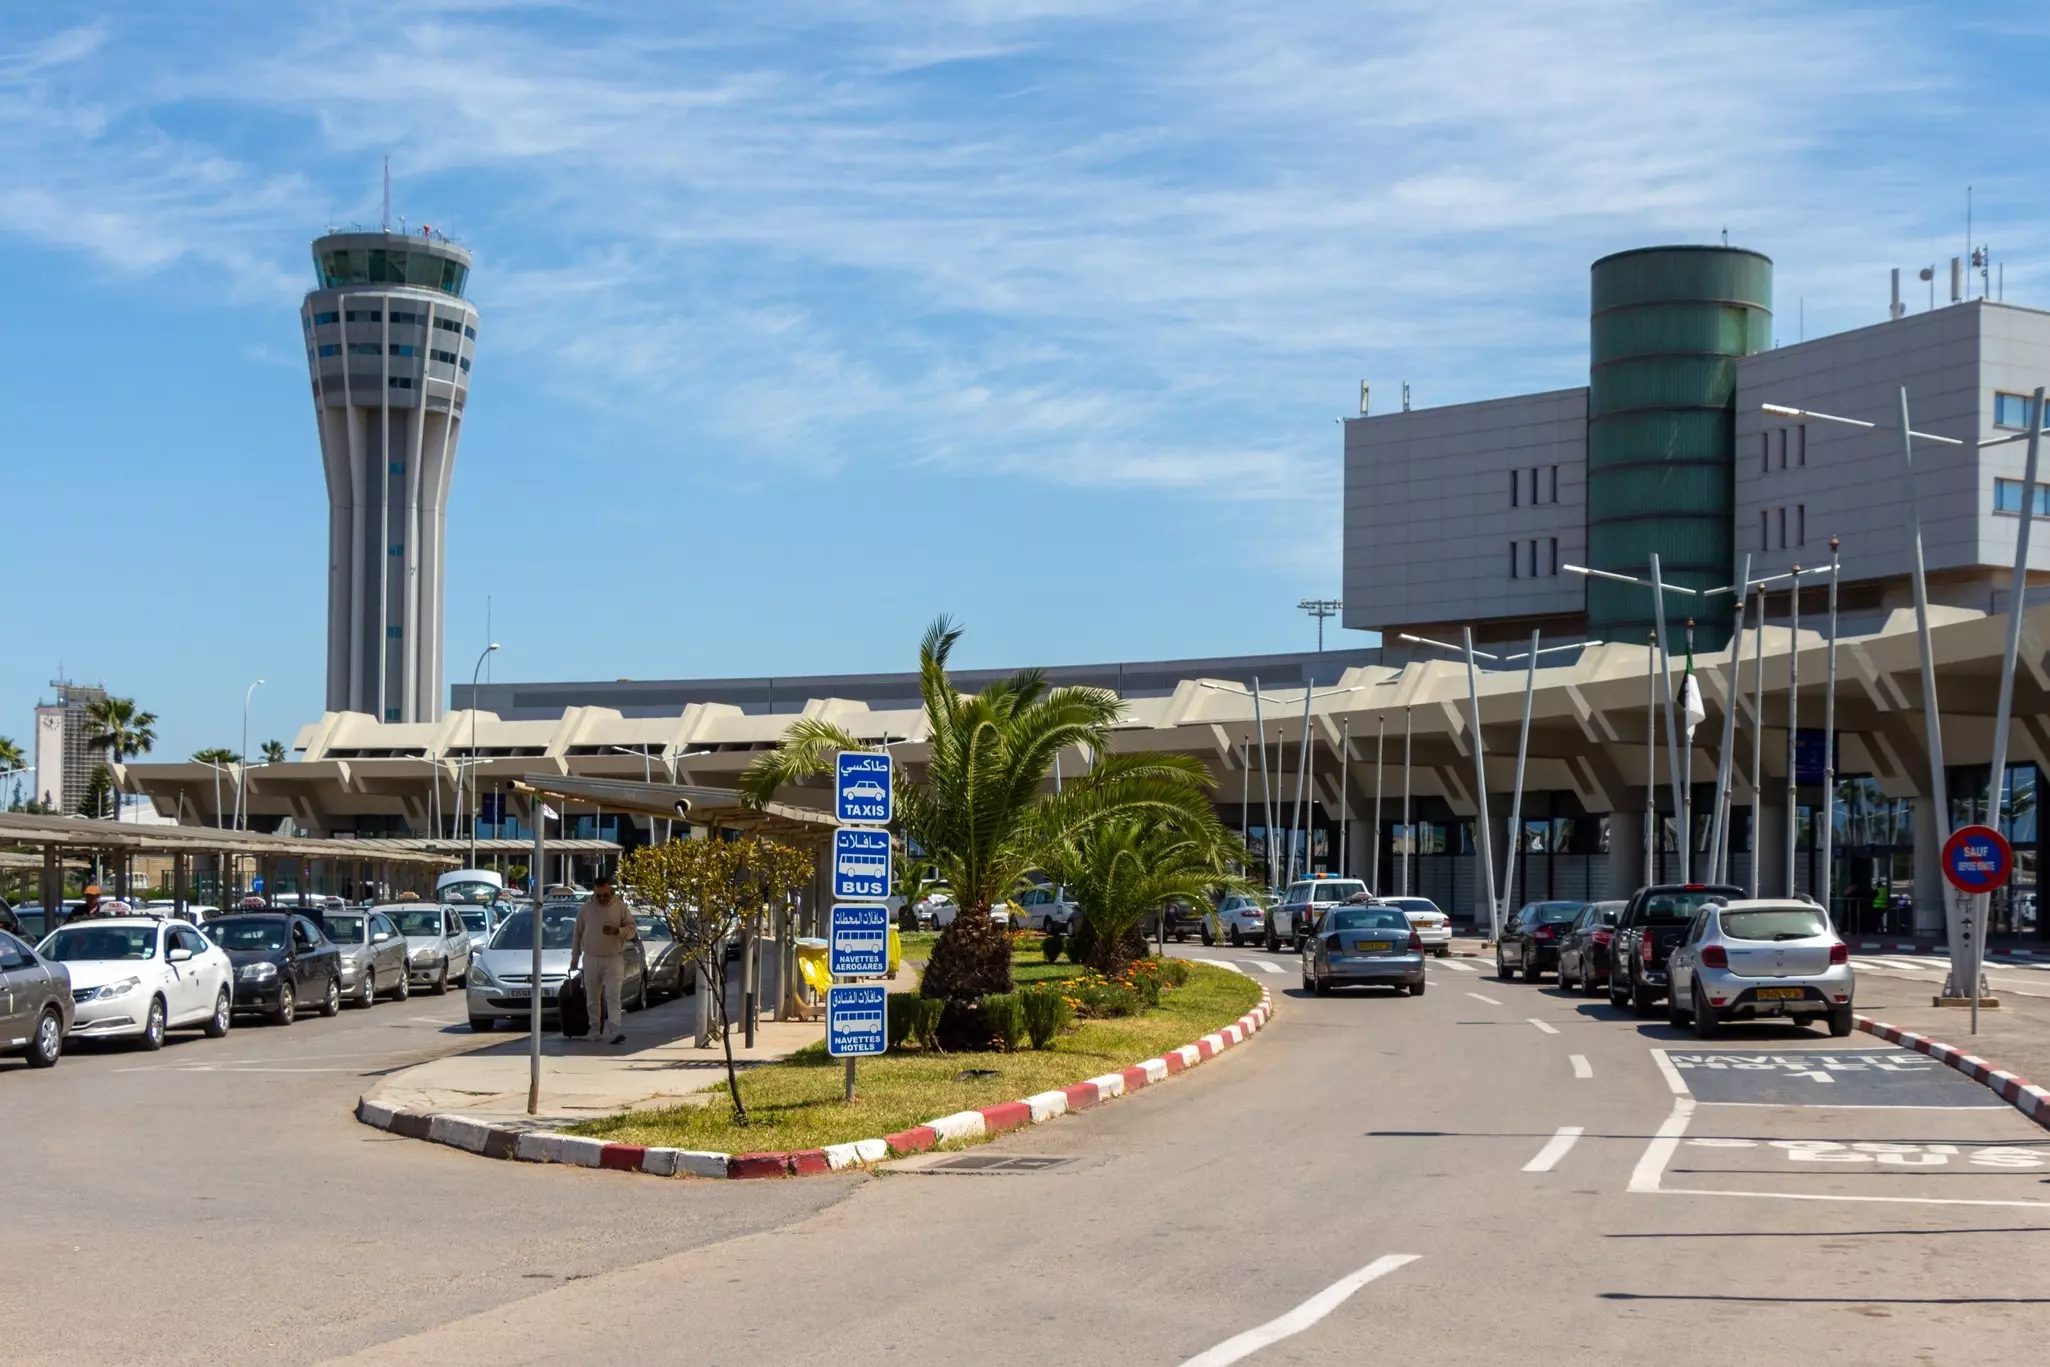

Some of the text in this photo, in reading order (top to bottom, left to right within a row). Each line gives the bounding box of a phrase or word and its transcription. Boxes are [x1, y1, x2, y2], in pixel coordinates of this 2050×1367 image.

[841, 759, 888, 776] طاكسي
[845, 804, 884, 816] TAXIS
[839, 834, 887, 848] حافلات
[1964, 846, 1988, 857] SAUF
[842, 881, 883, 894] BUS
[863, 911, 885, 925] حافلات
[840, 955, 879, 963] NAVETTES
[835, 963, 883, 971] AEROGARES
[858, 990, 883, 1004] حافلات
[835, 1036, 881, 1044] NAVETTES
[840, 1044, 875, 1052] HOTELS
[1670, 1054, 1939, 1063] NAVETTE
[1675, 1062, 1931, 1071] HOTEL
[1783, 1070, 1836, 1083] 1
[1787, 1149, 2044, 1168] BUS
